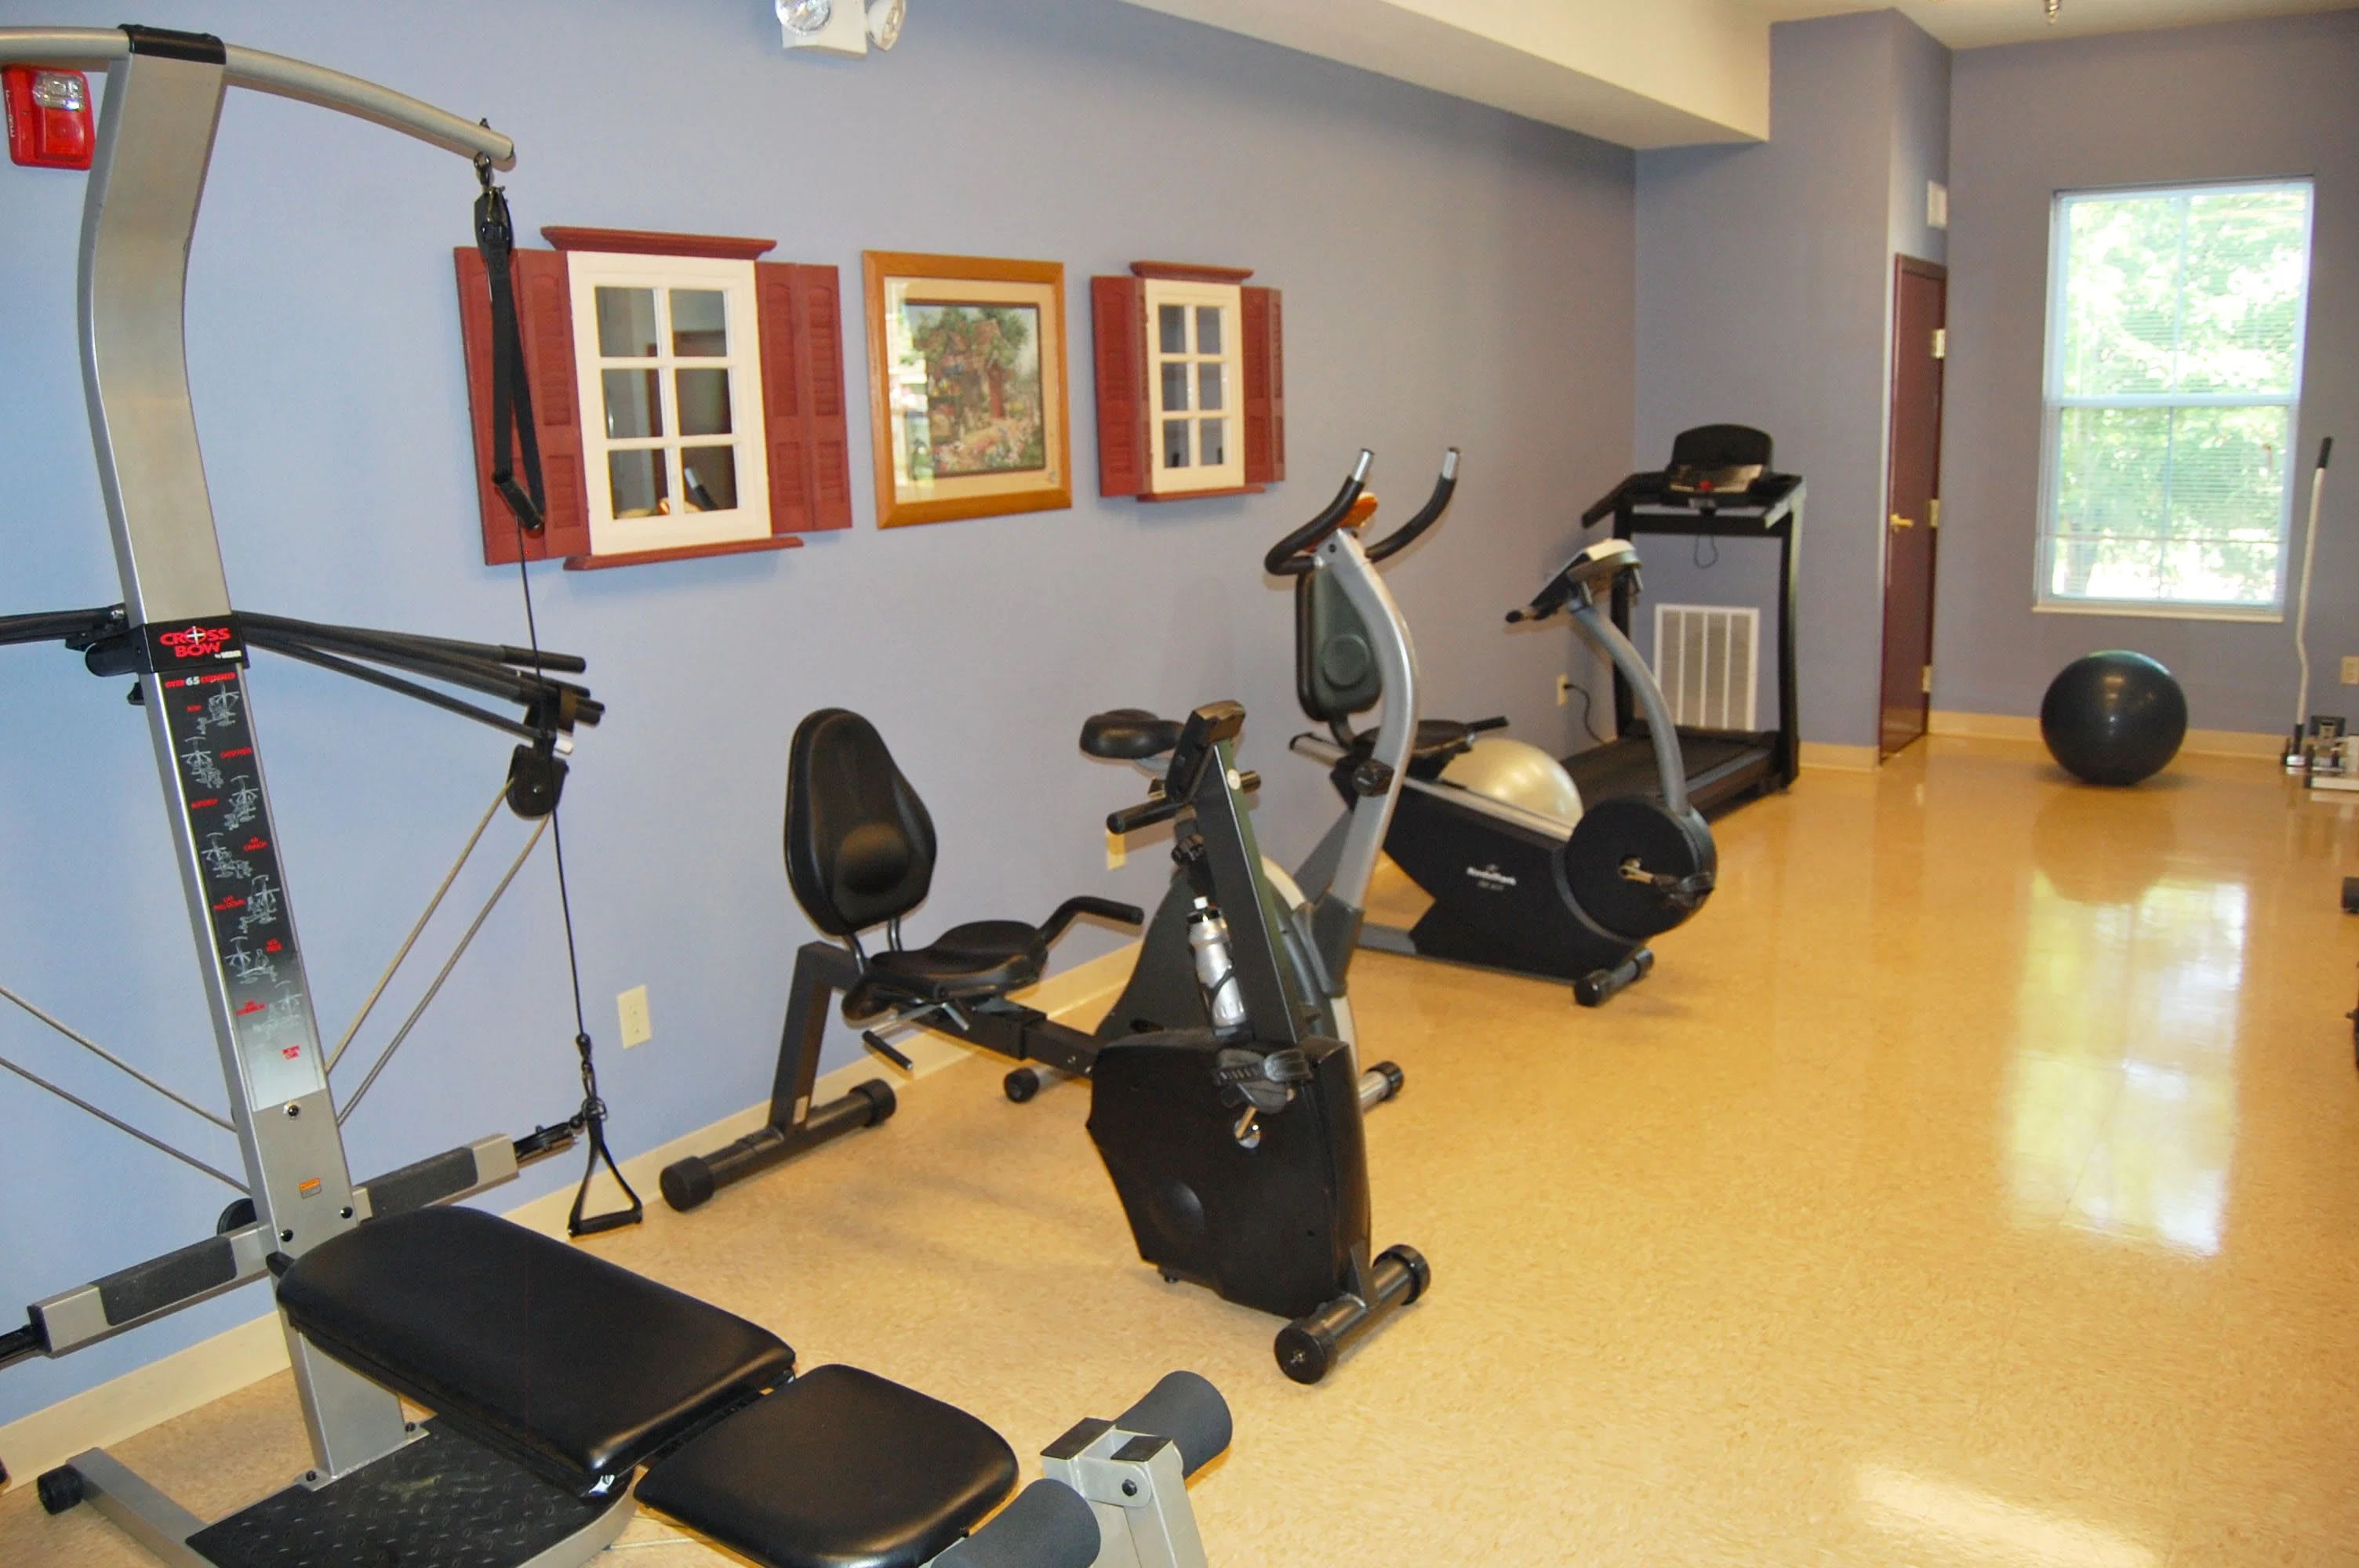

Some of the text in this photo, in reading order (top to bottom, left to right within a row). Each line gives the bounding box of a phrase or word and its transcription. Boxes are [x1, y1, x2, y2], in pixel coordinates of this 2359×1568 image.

[160, 626, 231, 645] CROSS
[174, 641, 221, 658] BOW
[186, 676, 200, 686] 65
